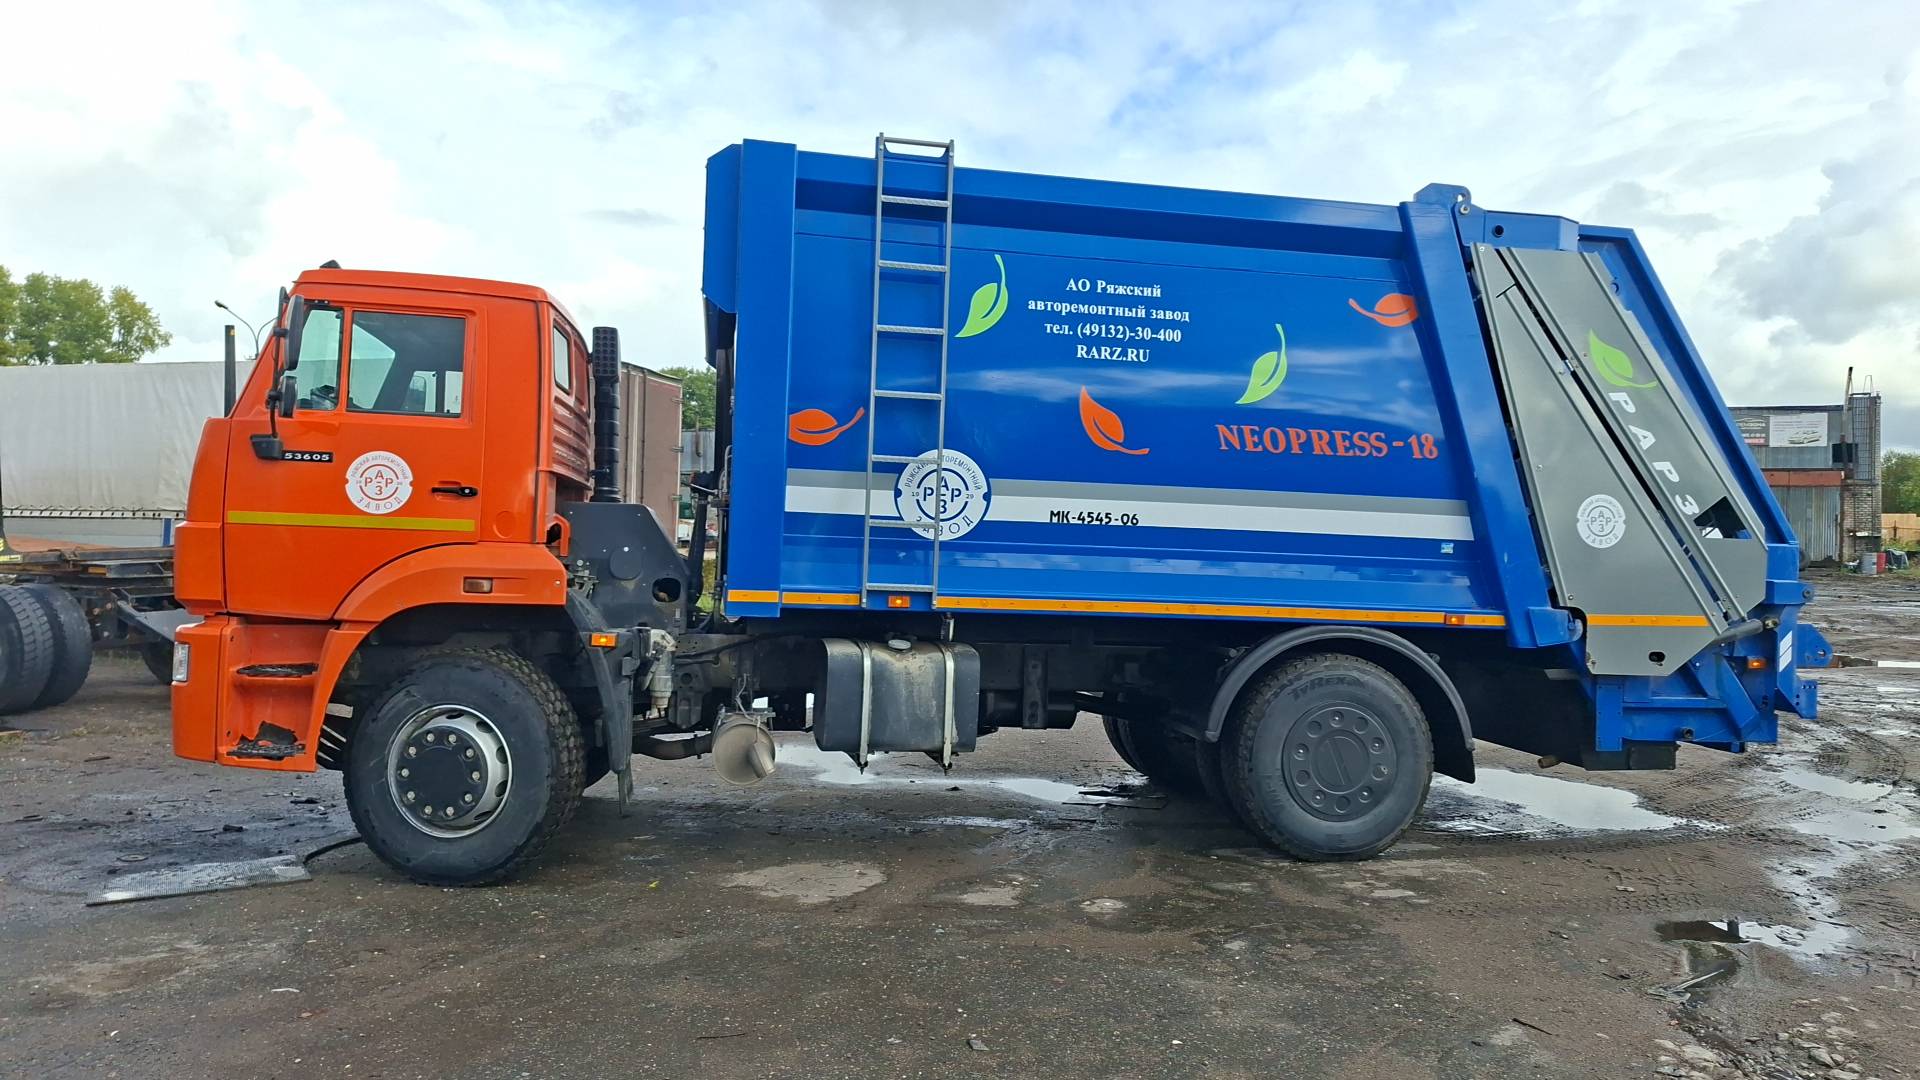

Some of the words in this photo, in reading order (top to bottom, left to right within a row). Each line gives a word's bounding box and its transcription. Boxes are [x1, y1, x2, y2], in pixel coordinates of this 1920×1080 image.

[1066, 278, 1091, 292] АО
[1096, 279, 1162, 298] Ряжский
[1028, 299, 1146, 319] авторемонтный
[1150, 311, 1190, 323] завод
[1044, 322, 1074, 335] тел.
[1077, 322, 1182, 343] (49132)-30-400
[1076, 344, 1150, 363] RARZ.RU
[284, 452, 330, 461] 53605
